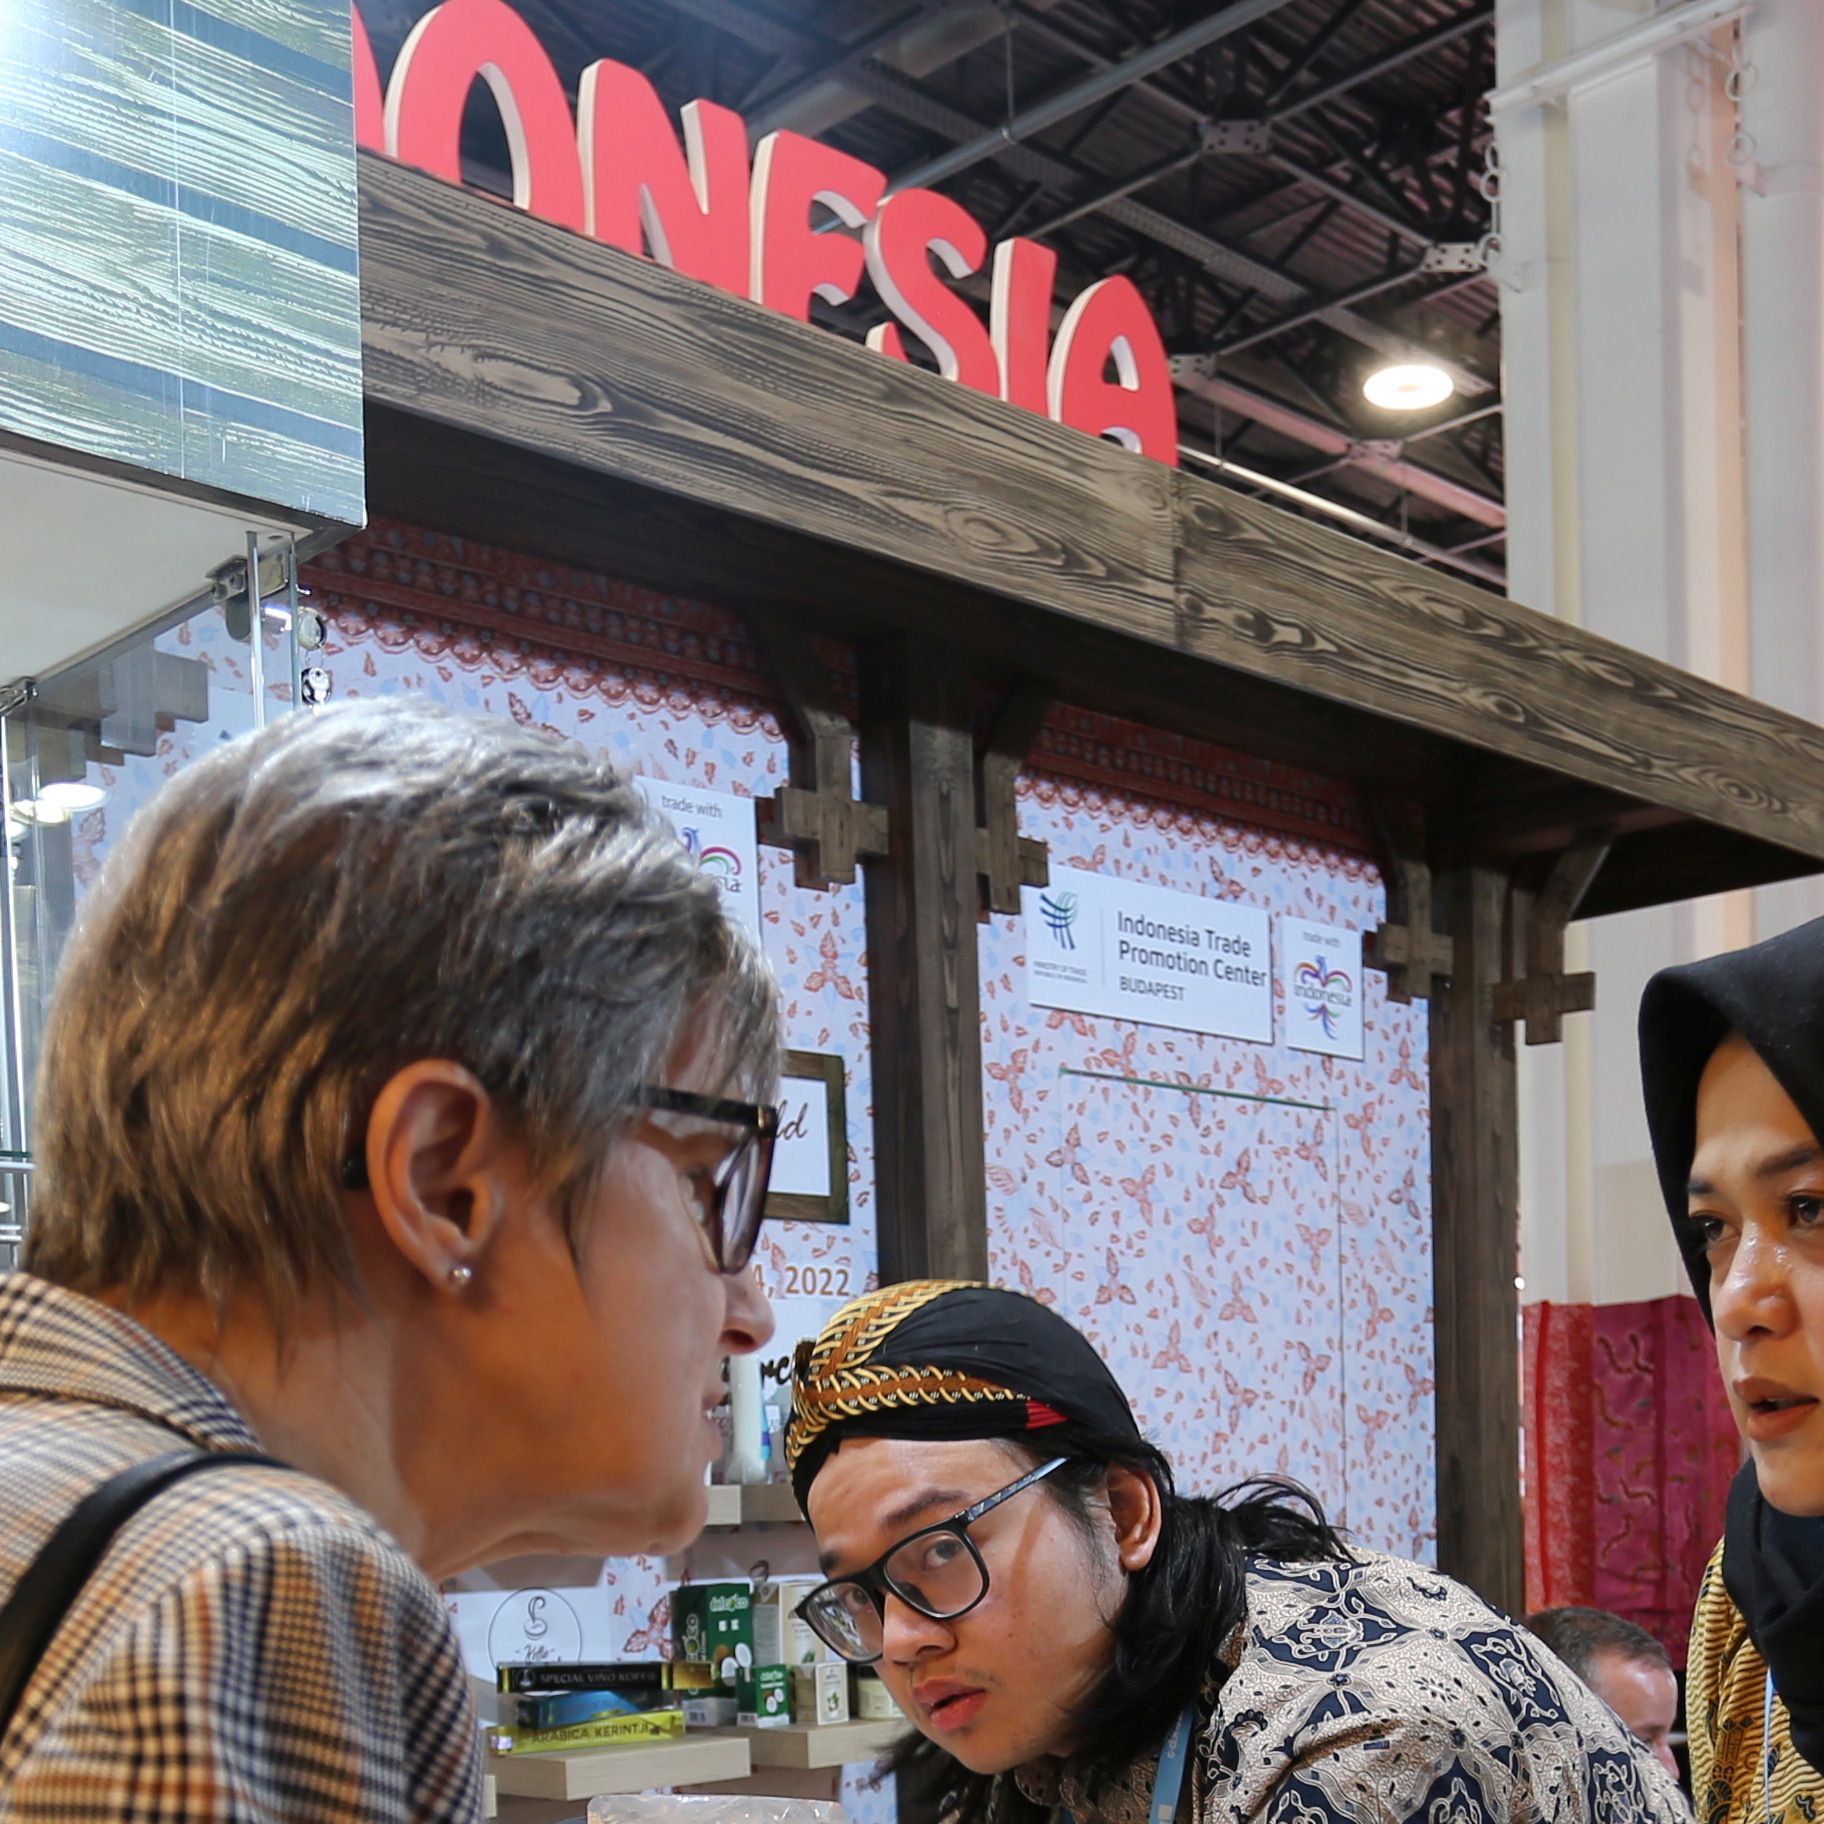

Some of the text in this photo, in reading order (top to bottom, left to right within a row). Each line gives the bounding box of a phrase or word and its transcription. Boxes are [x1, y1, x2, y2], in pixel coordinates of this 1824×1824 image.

[352, 0, 1177, 467] ONESIA
[662, 796, 722, 818] trade with
[1118, 911, 1251, 957] Indonesia Trade
[1303, 930, 1341, 948] trade with
[1119, 940, 1266, 987] Promotion Center
[1120, 976, 1185, 1001] BUDAPEST
[784, 1266, 850, 1297] 2022
[540, 1672, 584, 1684] SPECIAL
[532, 1729, 589, 1743] ARABICA
